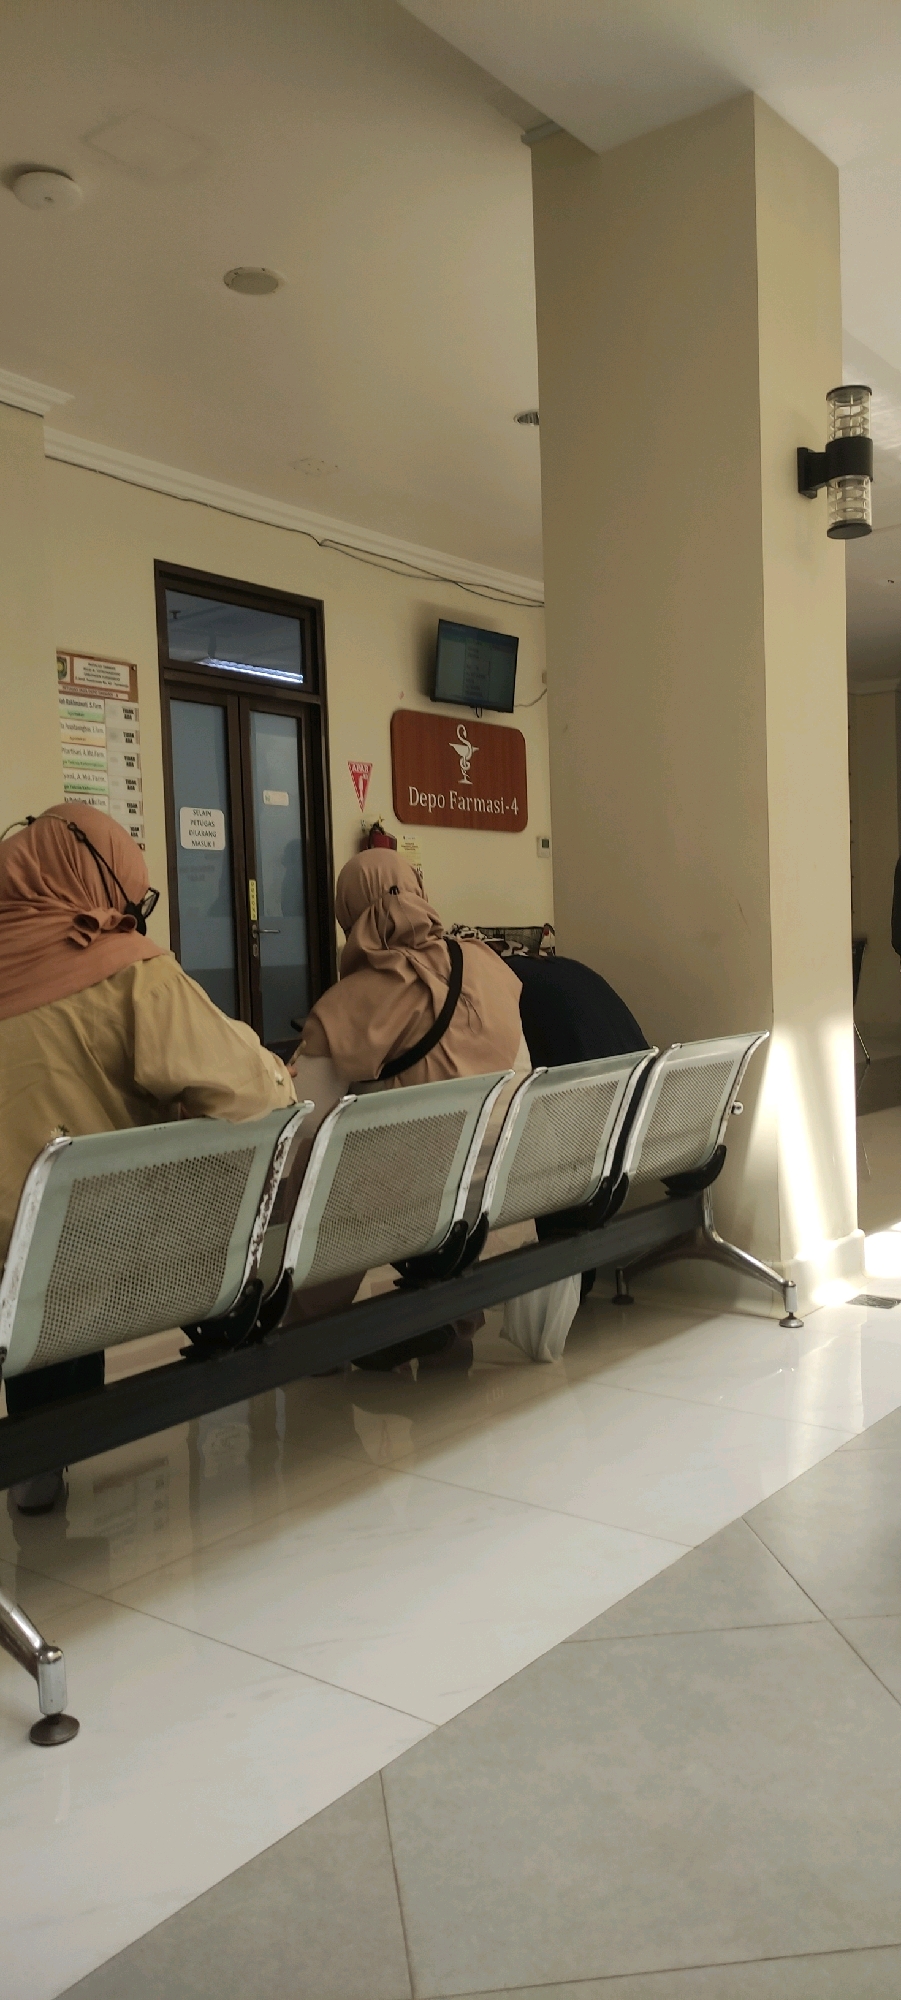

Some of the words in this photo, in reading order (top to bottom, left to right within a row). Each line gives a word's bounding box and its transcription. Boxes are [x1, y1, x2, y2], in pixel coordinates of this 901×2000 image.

[352, 763, 369, 772] APAR
[408, 786, 445, 813] Depo
[449, 790, 519, 815] Farmasi-4
[193, 809, 211, 817] SELAIN
[190, 819, 215, 827] PETUGAS
[188, 829, 217, 837] DILARANG
